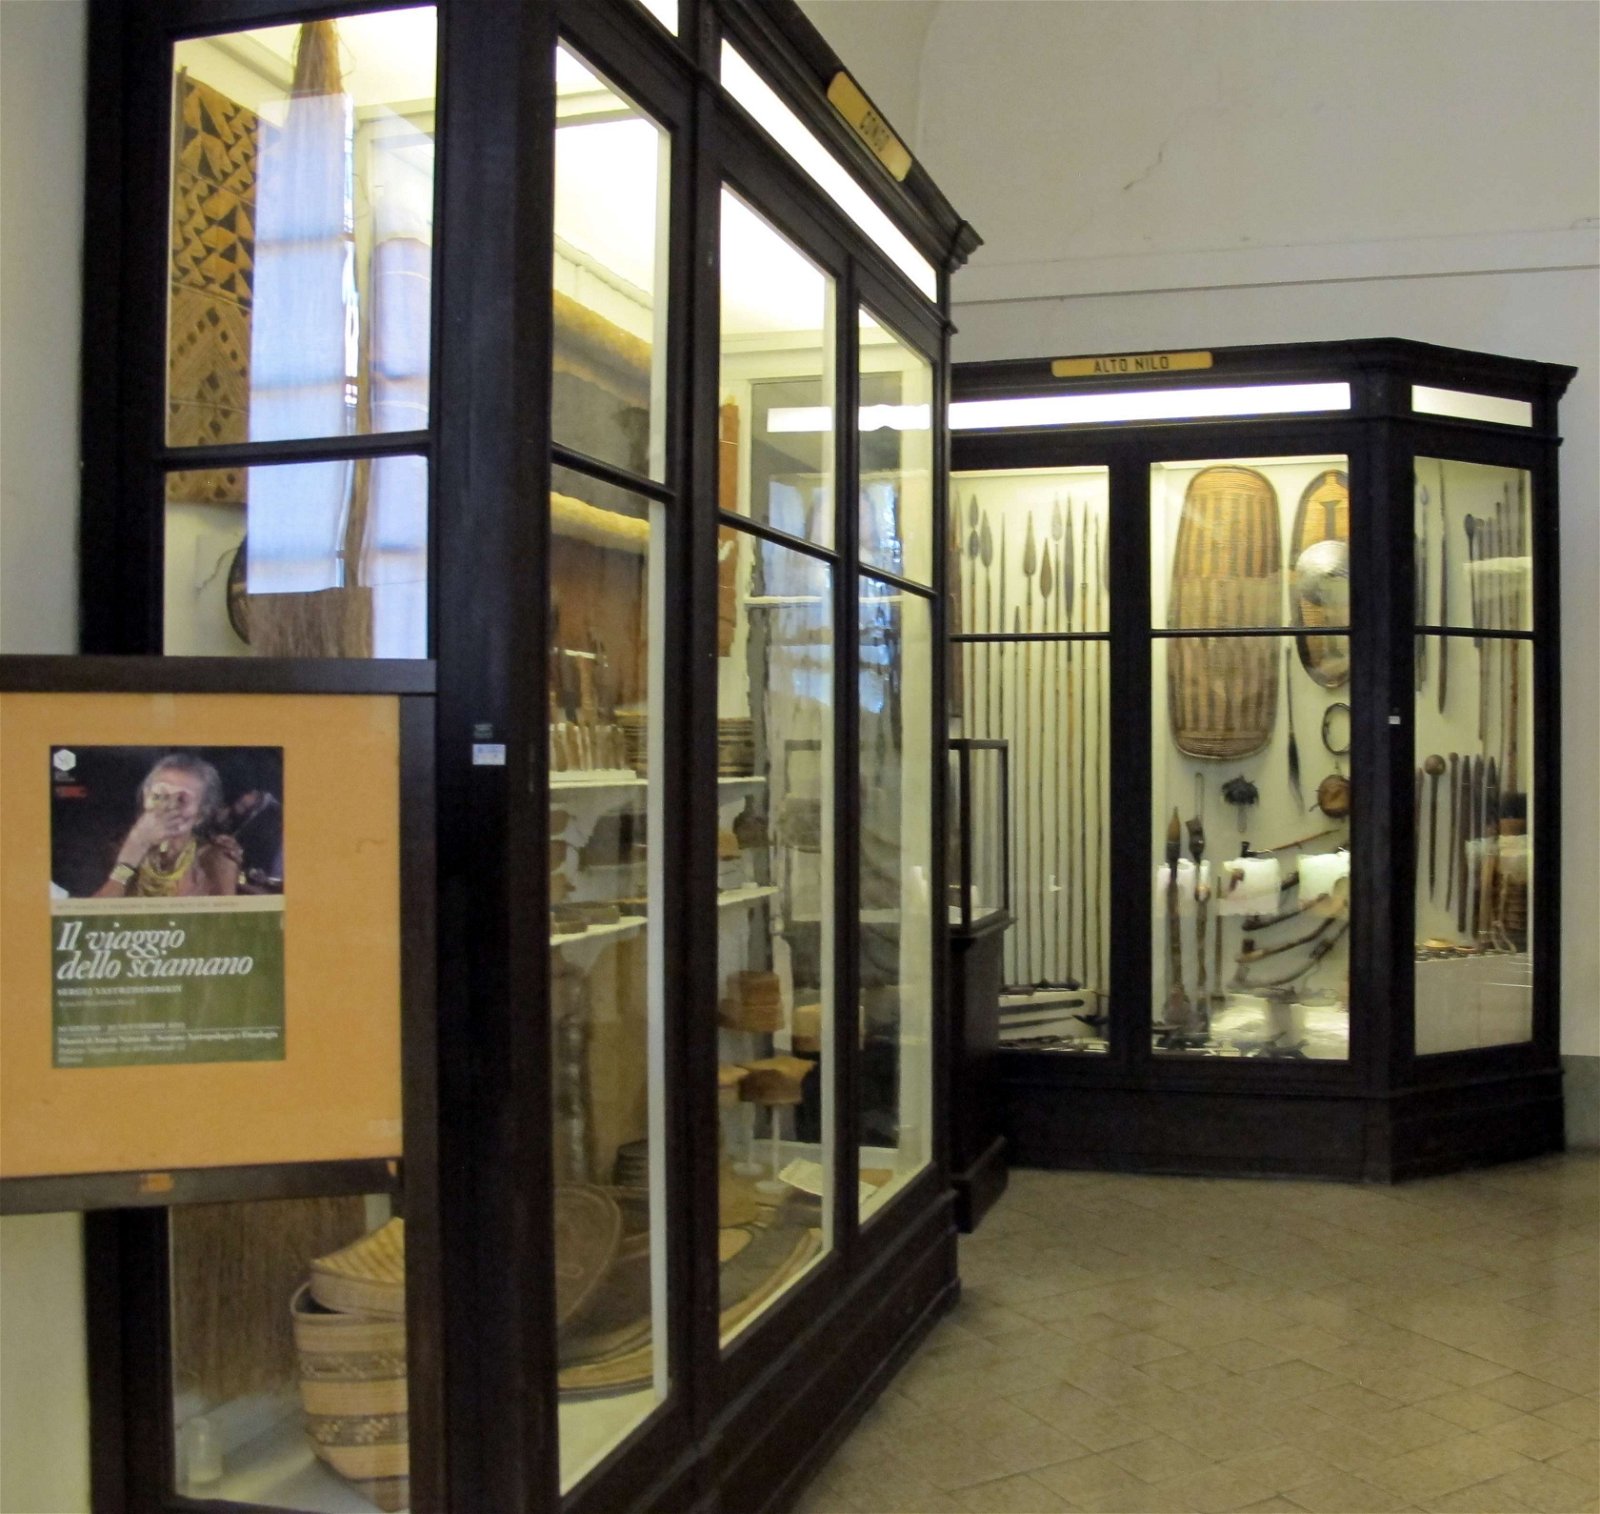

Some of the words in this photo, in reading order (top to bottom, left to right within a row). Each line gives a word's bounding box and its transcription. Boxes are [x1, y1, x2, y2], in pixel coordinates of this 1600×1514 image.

[1094, 358, 1128, 373] ALTO
[1135, 356, 1169, 371] NILO
[56, 921, 83, 951] Il
[86, 921, 186, 959] viaggio
[56, 951, 122, 980] dello
[126, 950, 254, 978] sciamano
